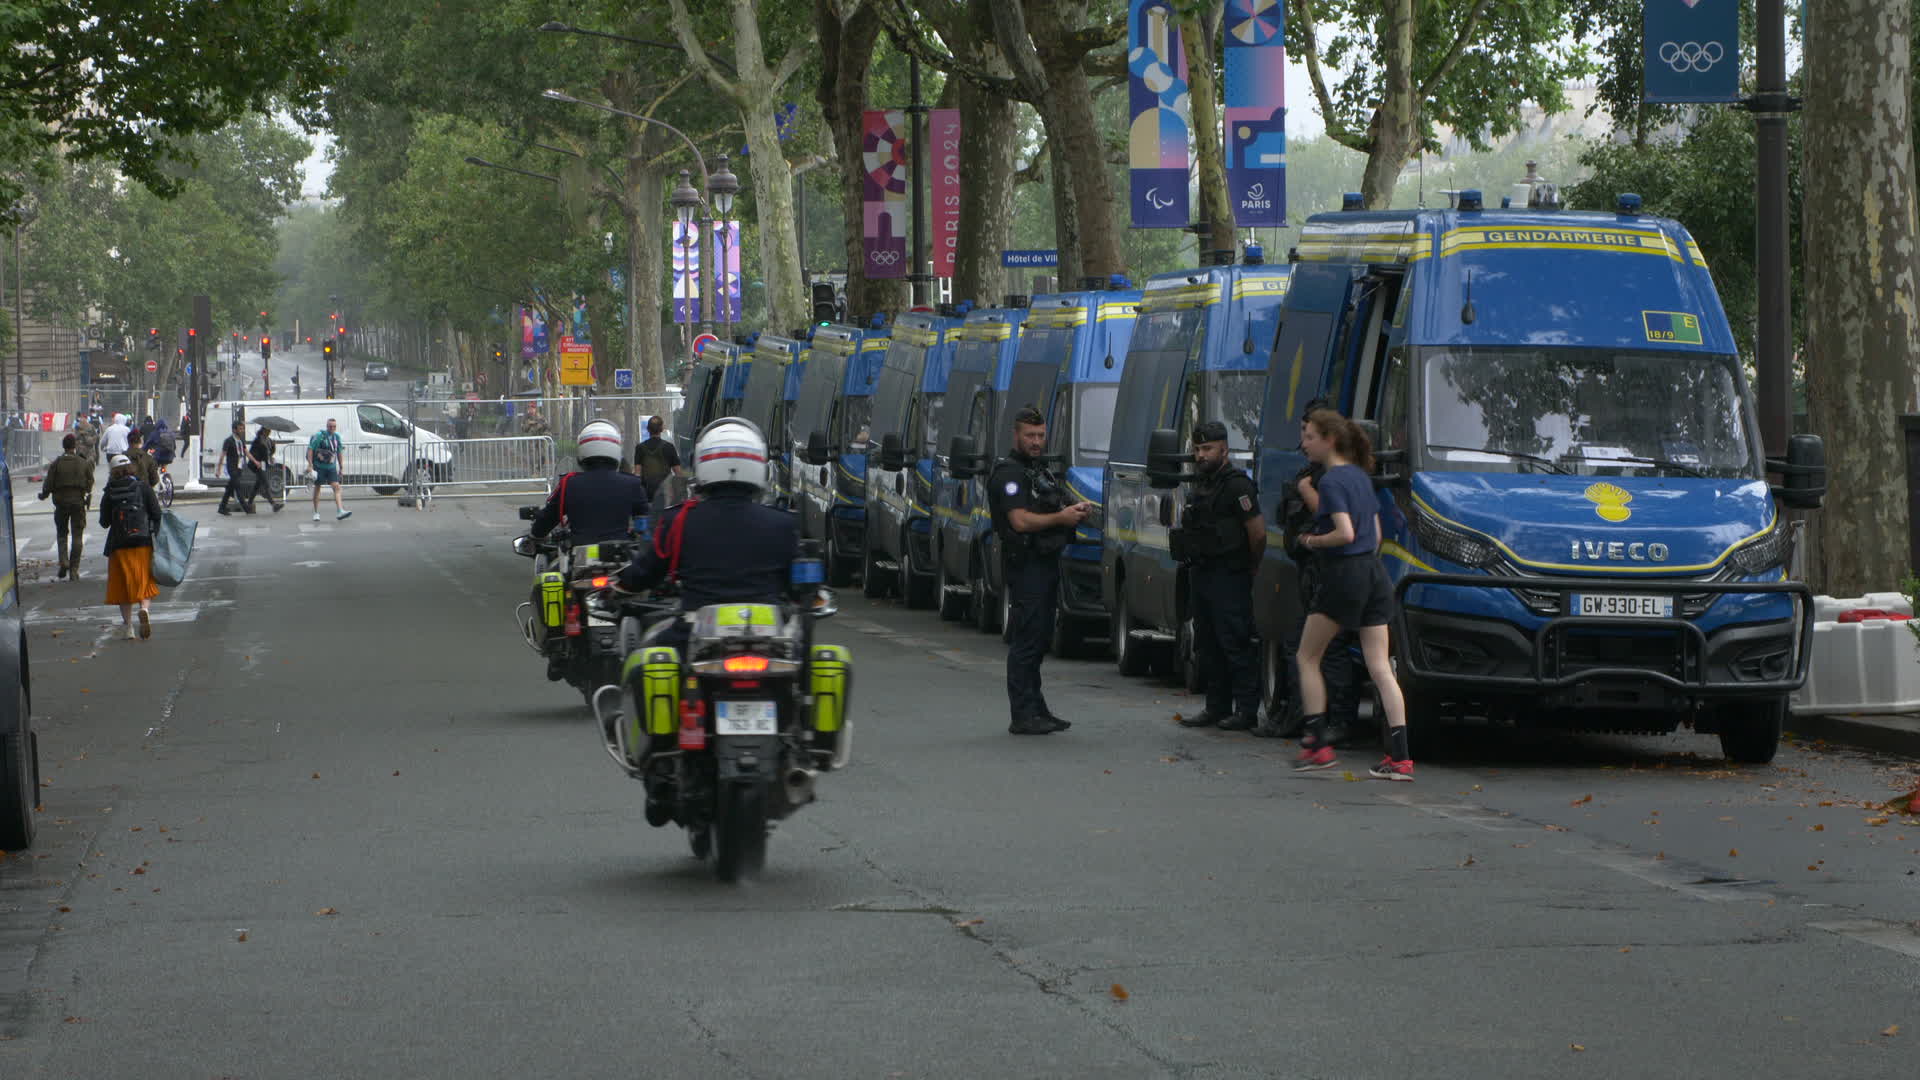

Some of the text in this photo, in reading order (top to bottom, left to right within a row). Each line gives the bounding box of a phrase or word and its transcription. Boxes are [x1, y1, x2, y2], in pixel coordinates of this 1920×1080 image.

[944, 124, 960, 185] 2024
[1241, 200, 1271, 208] PARIS
[1488, 231, 1637, 246] GENDARMERIE
[1032, 254, 1042, 263] de
[1044, 254, 1058, 262] Vill
[1683, 316, 1697, 328] E
[1648, 330, 1675, 340] 18/9
[1571, 540, 1668, 561] IVECO
